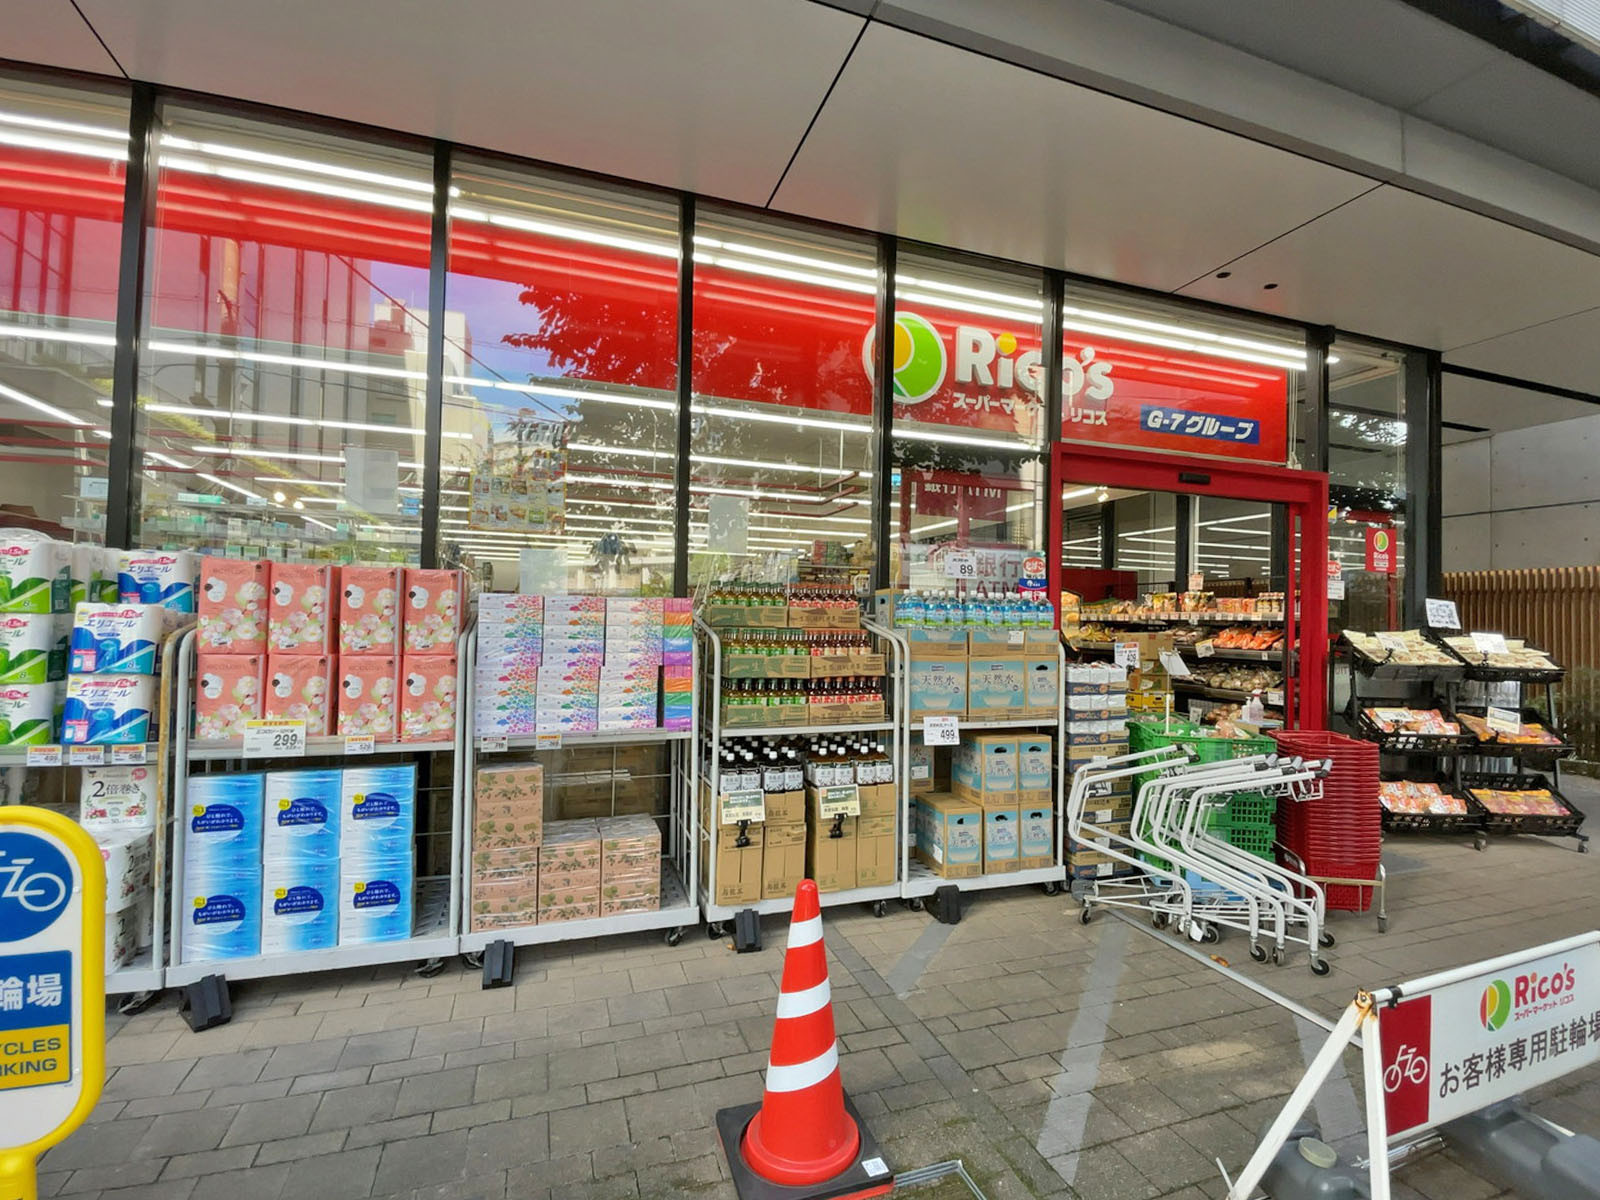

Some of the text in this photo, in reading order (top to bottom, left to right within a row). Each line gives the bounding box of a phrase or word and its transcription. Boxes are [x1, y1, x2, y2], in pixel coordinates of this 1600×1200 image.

[955, 325, 1114, 401] Rico's
[1071, 407, 1108, 426] リコス
[127, 565, 172, 573] エリエール
[960, 563, 974, 575] 89
[85, 619, 137, 629] エリエール
[921, 674, 955, 686] 天然水
[983, 673, 1014, 685] 天然水
[76, 689, 132, 698] エリエール
[91, 780, 141, 798] 2倍巻き
[1515, 962, 1575, 1009] Rico's
[1514, 1001, 1558, 1022] スーパーマーケット
[0, 1038, 61, 1056] CLES
[0, 1058, 57, 1076] KING
